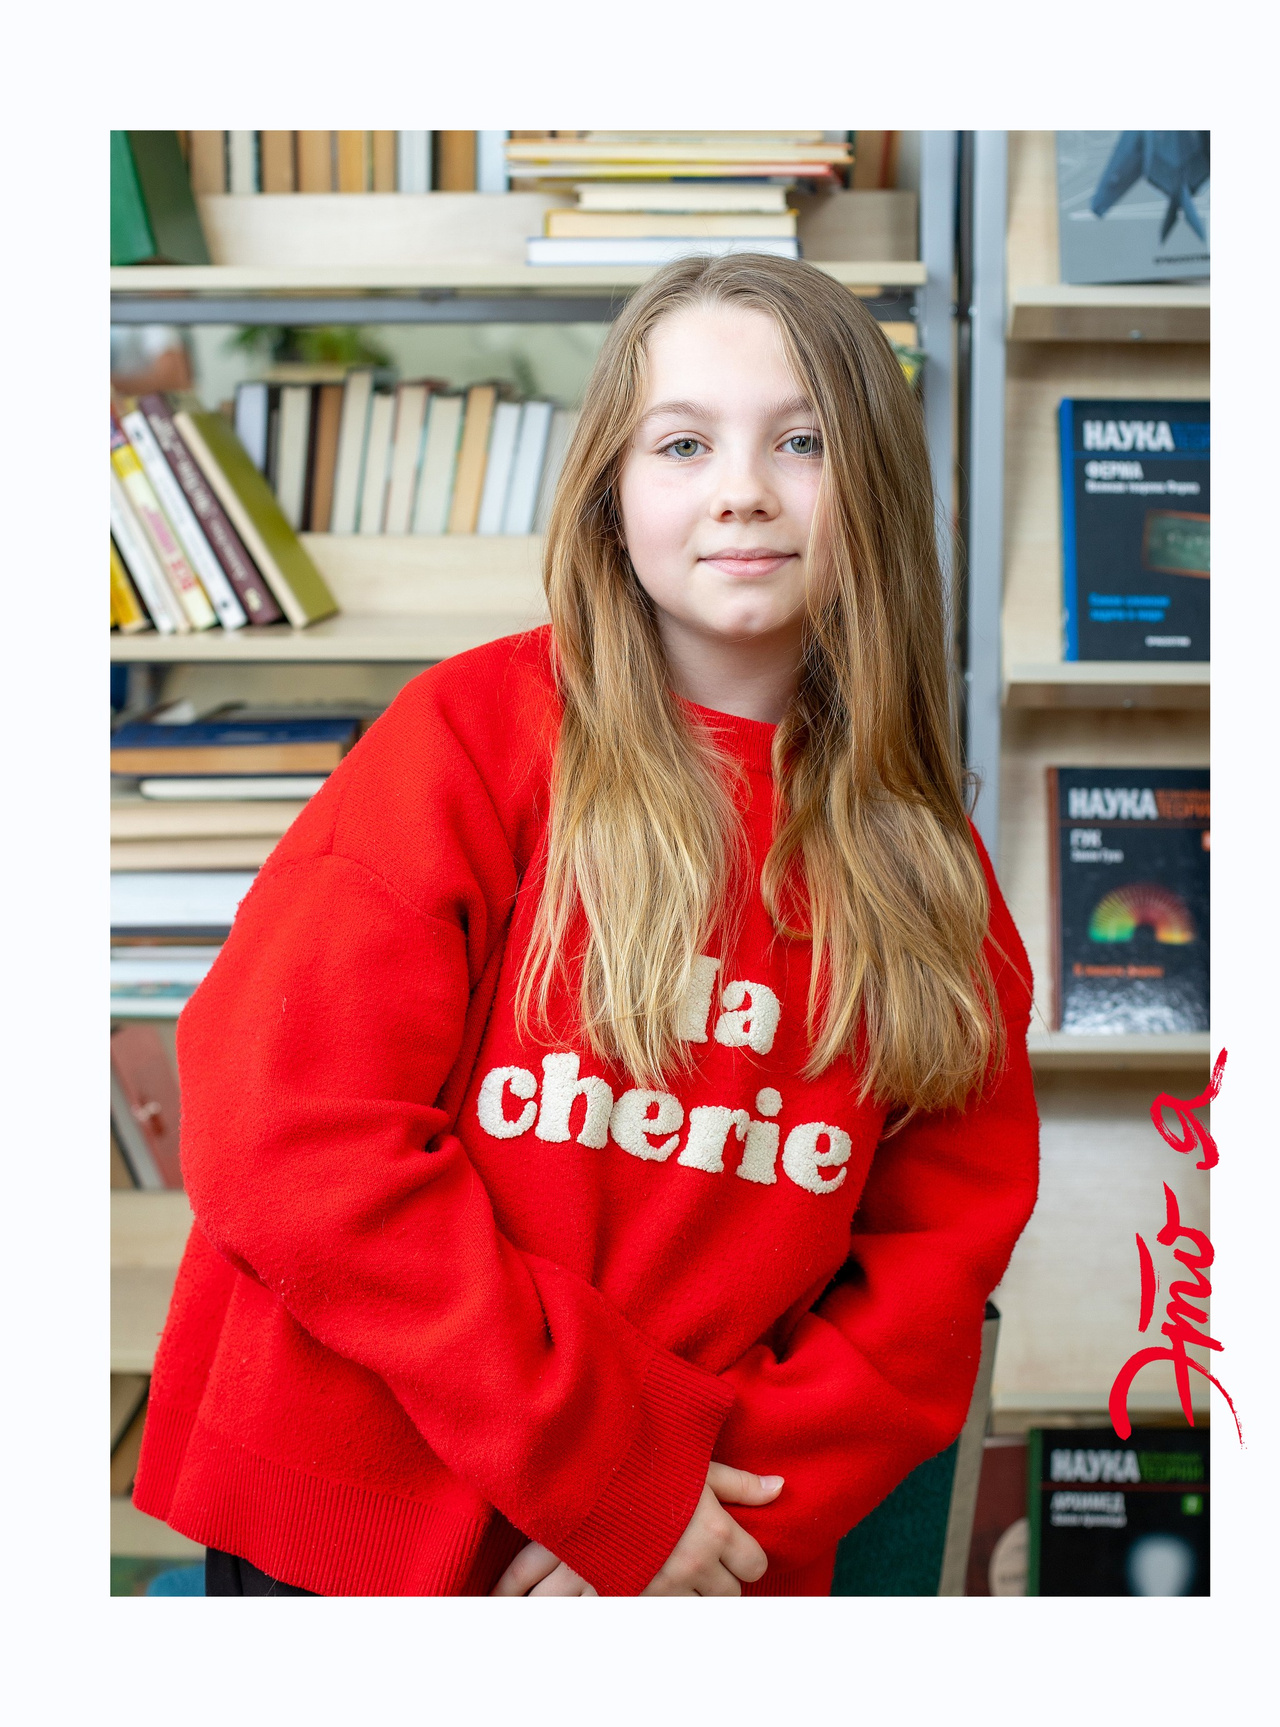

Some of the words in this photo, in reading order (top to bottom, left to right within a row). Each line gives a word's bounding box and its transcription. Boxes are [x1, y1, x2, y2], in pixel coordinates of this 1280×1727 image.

[1083, 420, 1175, 451] НАУКА
[1068, 787, 1159, 820] НАУКА
[677, 955, 782, 1055] la
[477, 1052, 853, 1195] cherie
[1051, 1449, 1142, 1483] НАУКА
